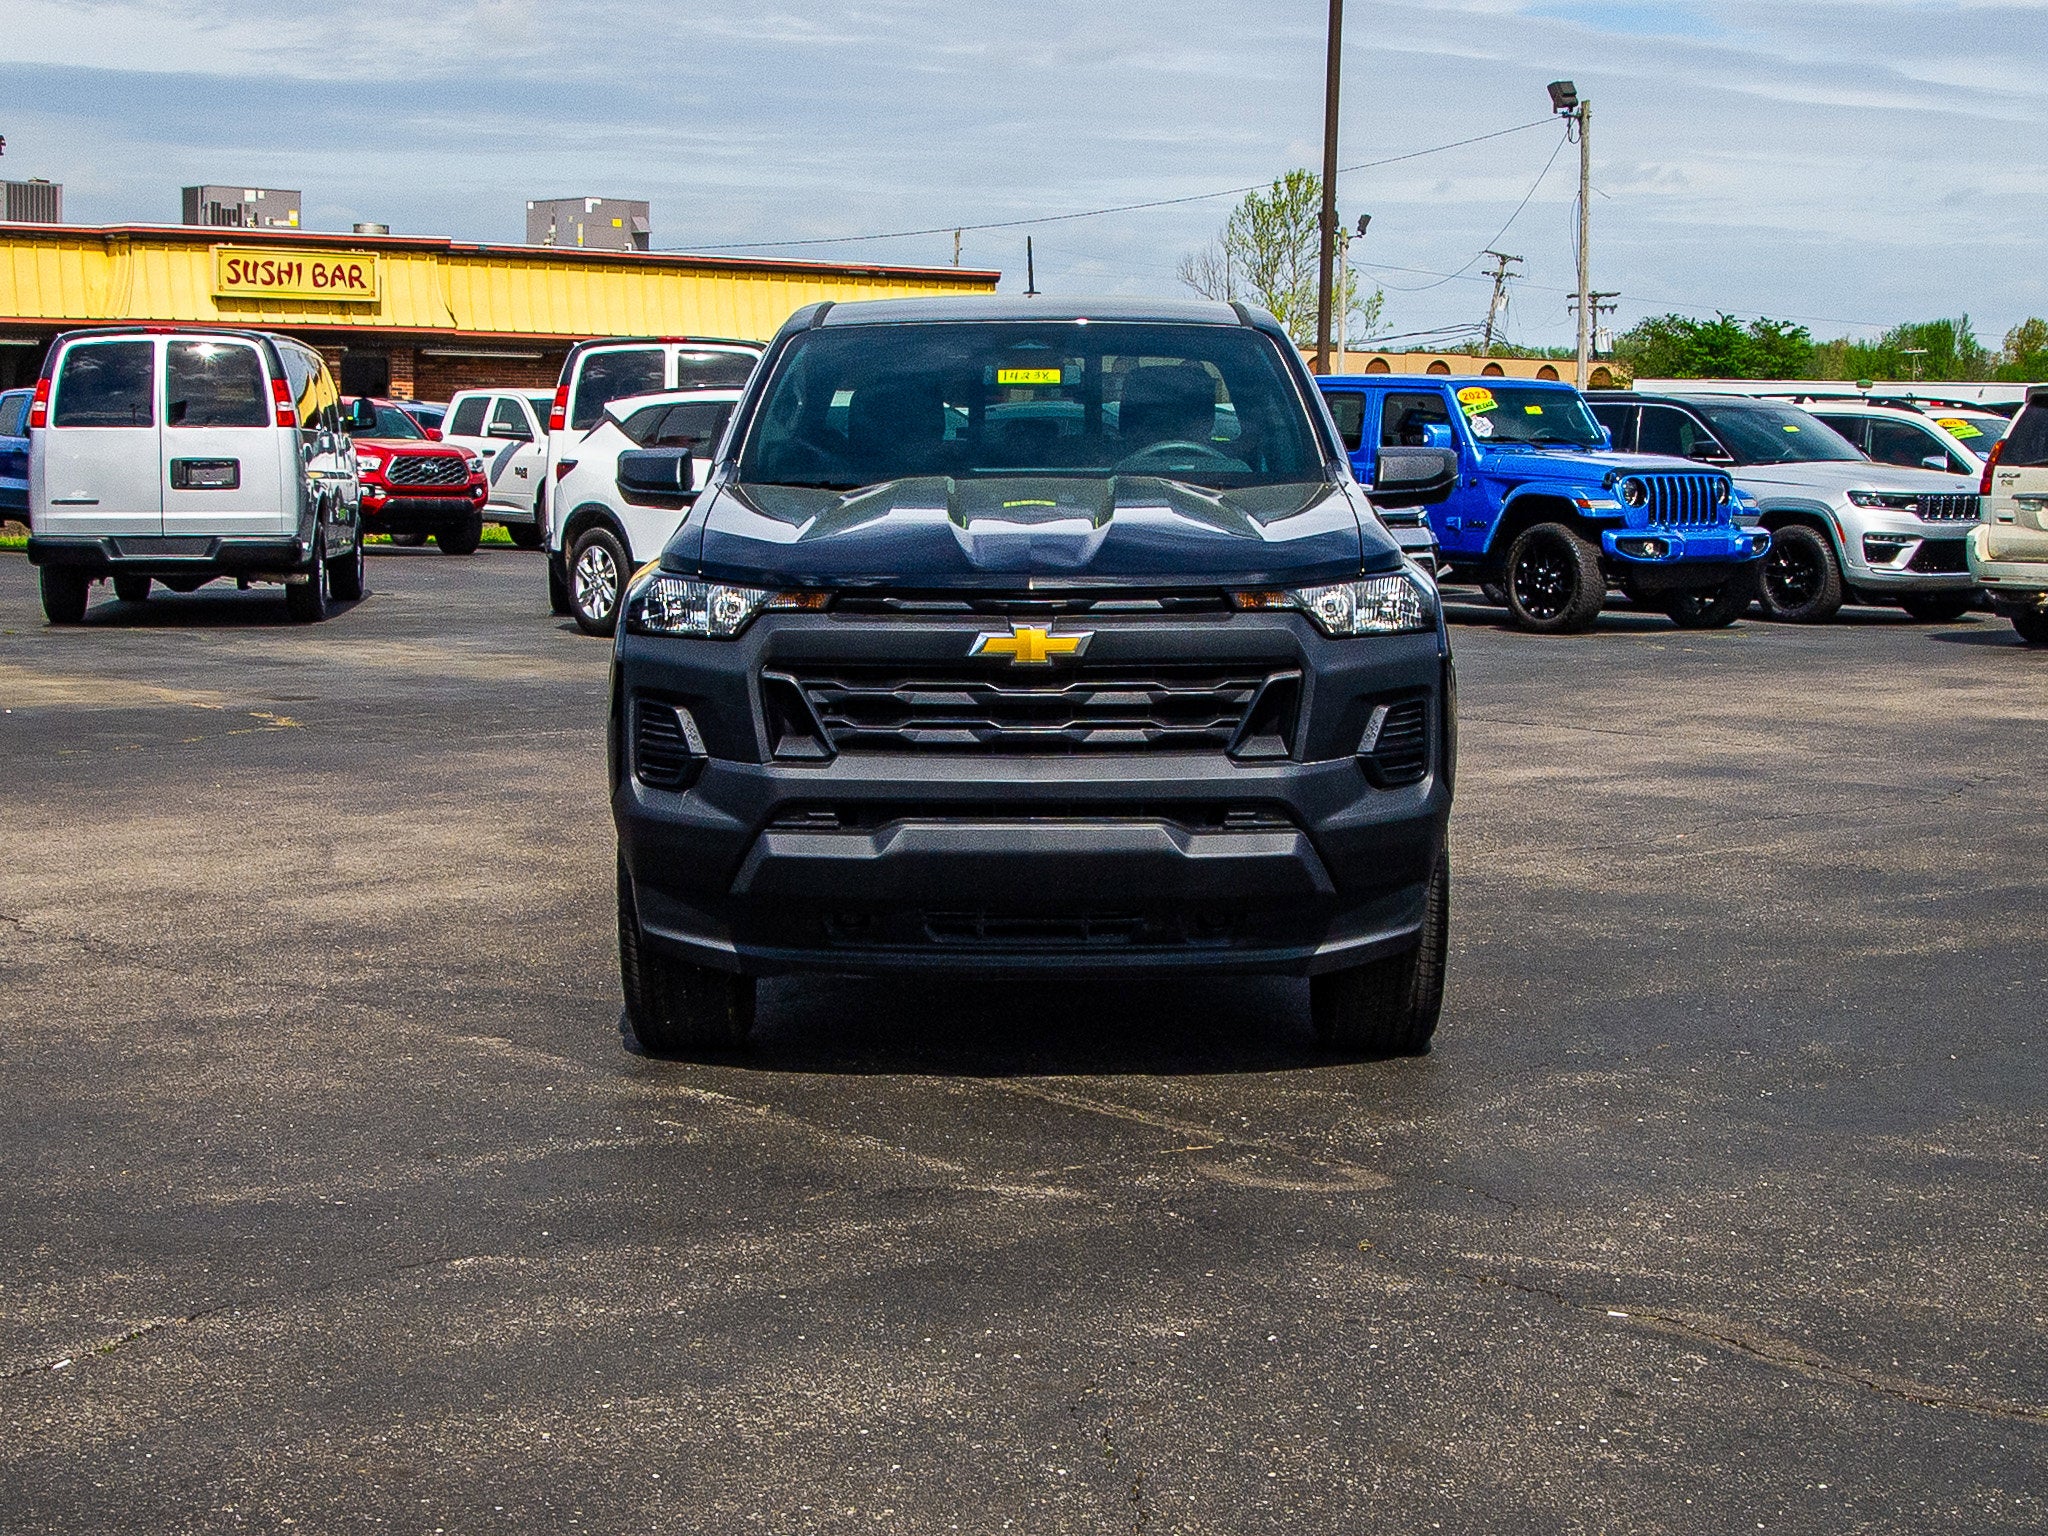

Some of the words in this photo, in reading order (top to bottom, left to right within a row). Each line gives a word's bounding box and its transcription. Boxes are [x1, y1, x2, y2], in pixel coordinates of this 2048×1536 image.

[227, 259, 302, 287] SUSHI
[312, 262, 367, 289] BAR
[1462, 390, 1488, 400] 2023
